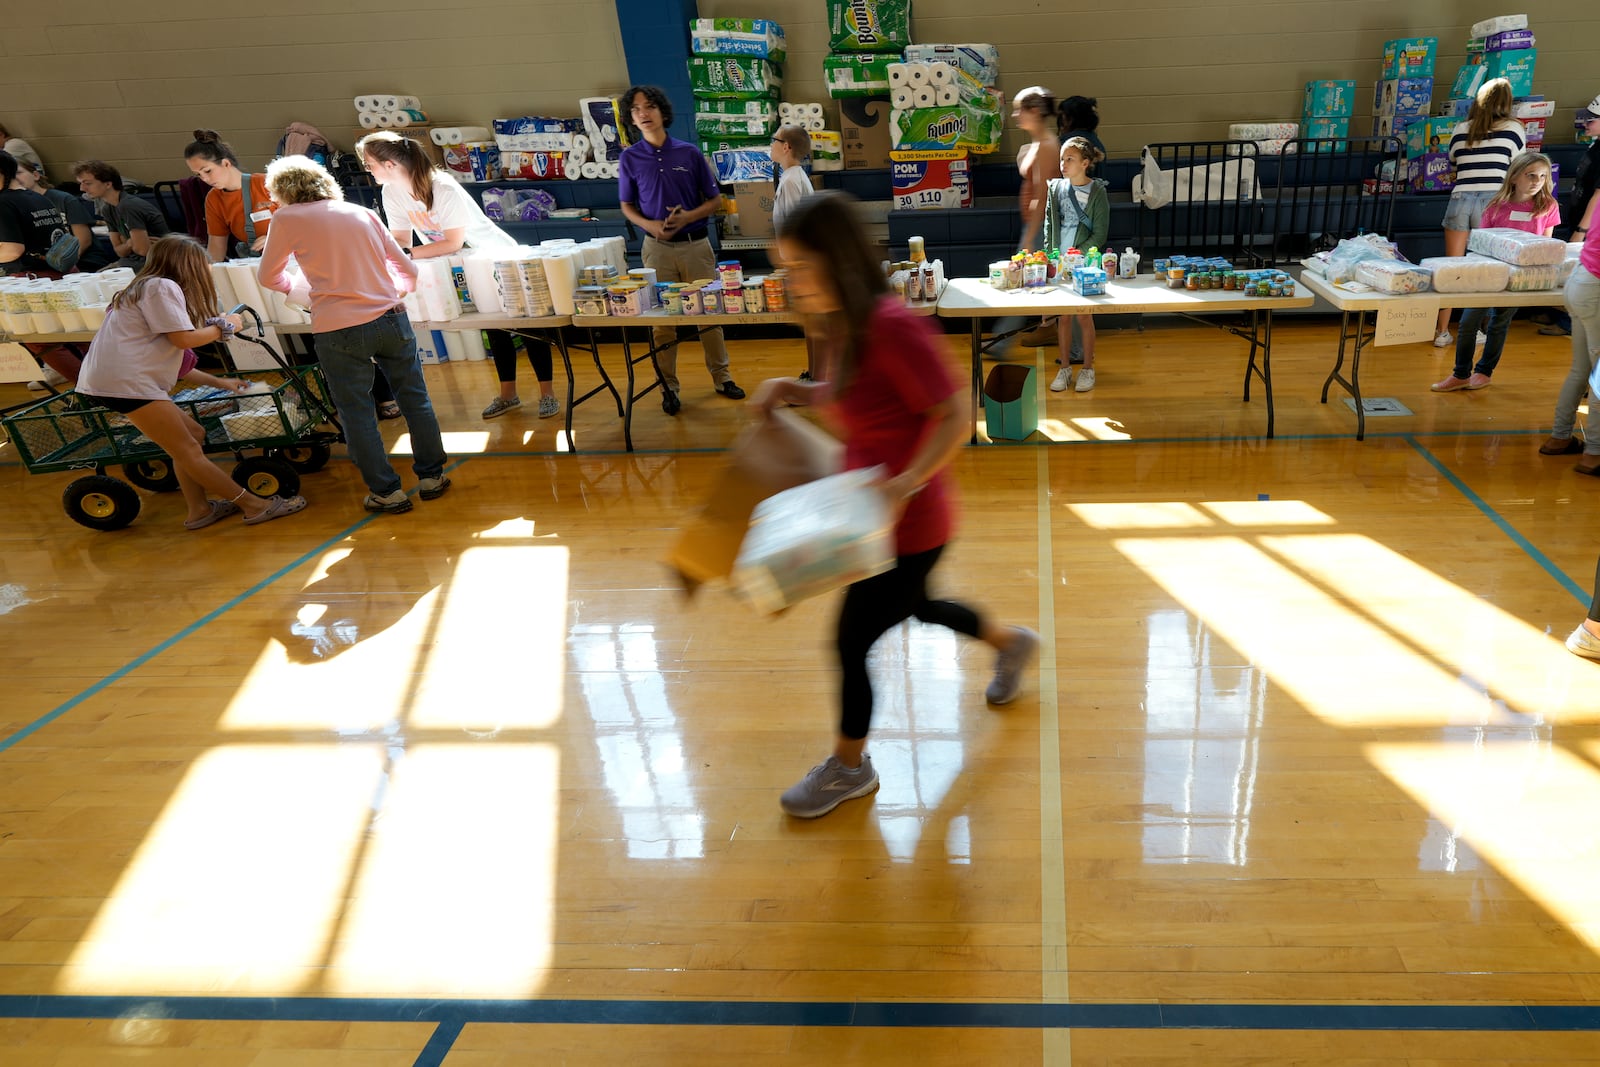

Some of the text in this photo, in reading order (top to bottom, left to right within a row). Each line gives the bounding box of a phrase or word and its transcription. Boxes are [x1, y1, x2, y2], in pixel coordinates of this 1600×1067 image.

[1406, 43, 1428, 51] Pampers
[1507, 63, 1529, 71] Pampers
[715, 61, 724, 86] MOST
[725, 58, 743, 88] Bounty
[928, 115, 967, 138] Bounty
[894, 164, 918, 174] POM
[899, 196, 912, 206] 30
[919, 192, 942, 203] 110
[1387, 307, 1427, 321] Baby Food
